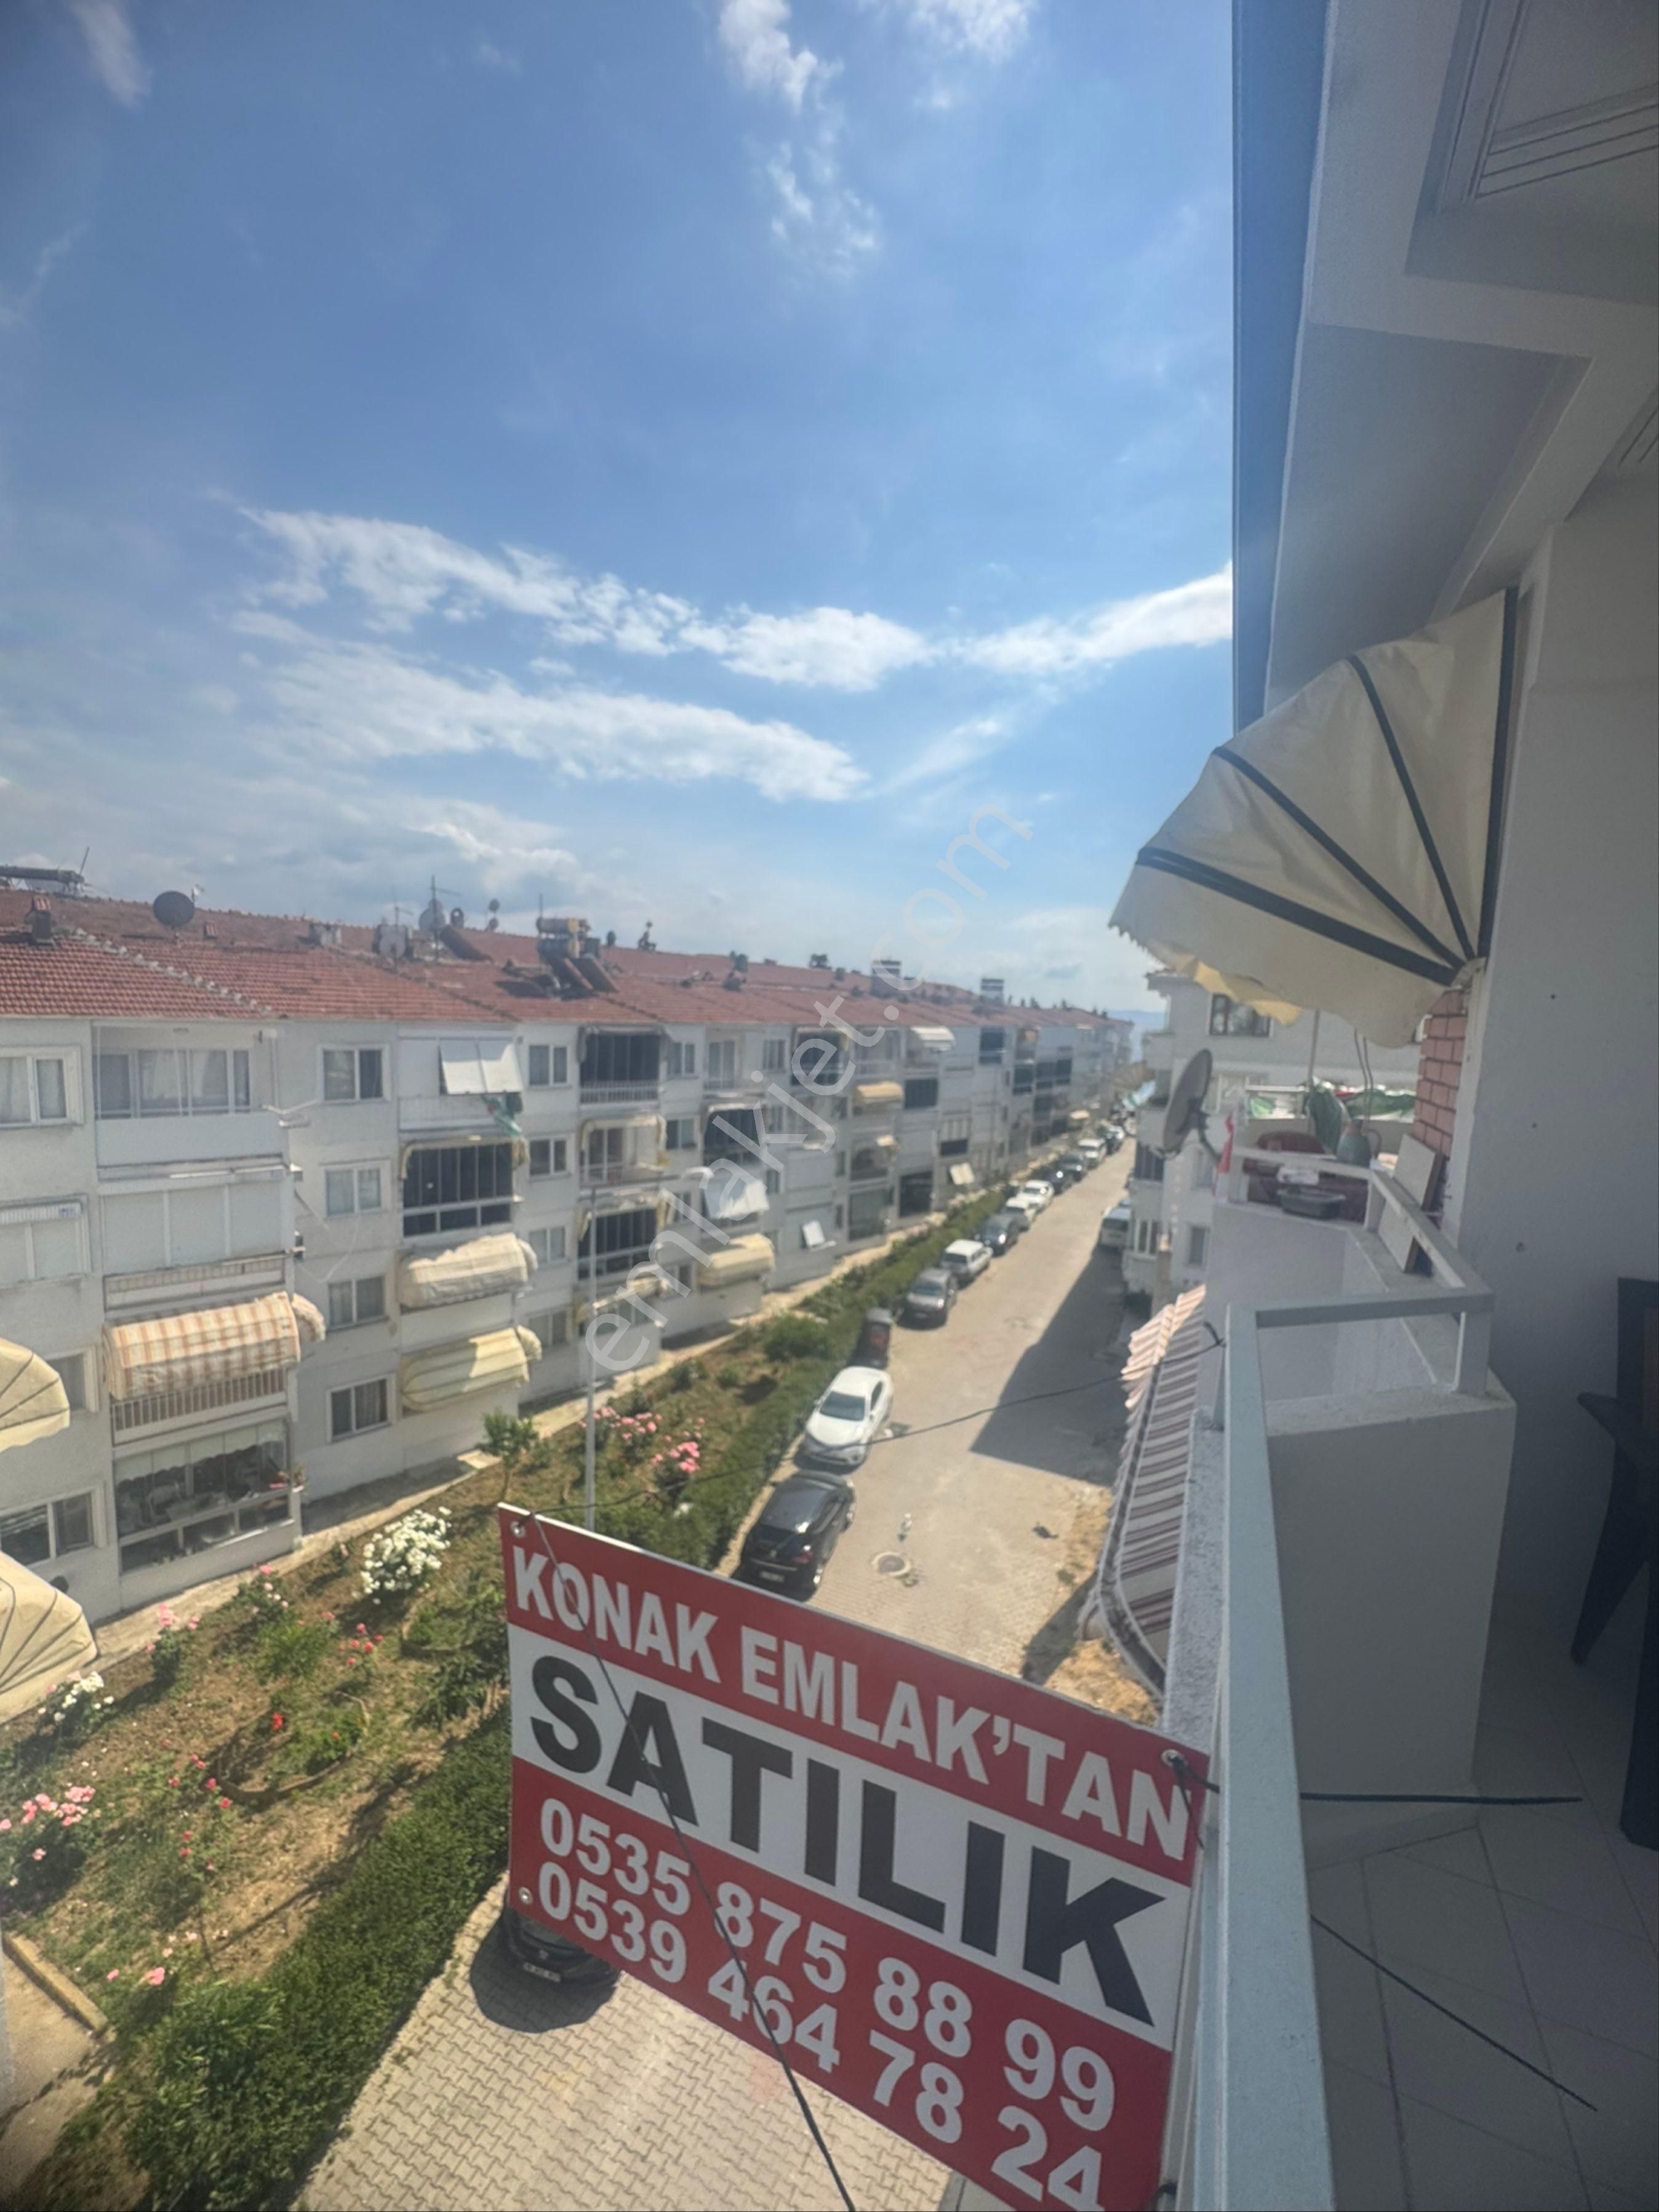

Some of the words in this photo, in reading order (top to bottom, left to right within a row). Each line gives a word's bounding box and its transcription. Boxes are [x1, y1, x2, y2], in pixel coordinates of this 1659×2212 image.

[512, 1546, 721, 1683] KONAK
[741, 1626, 1192, 1862] EMLAK'TAN
[530, 1656, 1165, 2027] SATILIK
[539, 1863, 687, 1984] 0539
[707, 1961, 840, 2072] 464
[869, 2030, 964, 2144] 78
[990, 2106, 1105, 2212] 24
[540, 1799, 691, 1915] 0535
[715, 1884, 847, 1994] 875
[873, 1957, 972, 2058] 88
[1004, 2018, 1115, 2131] 99
